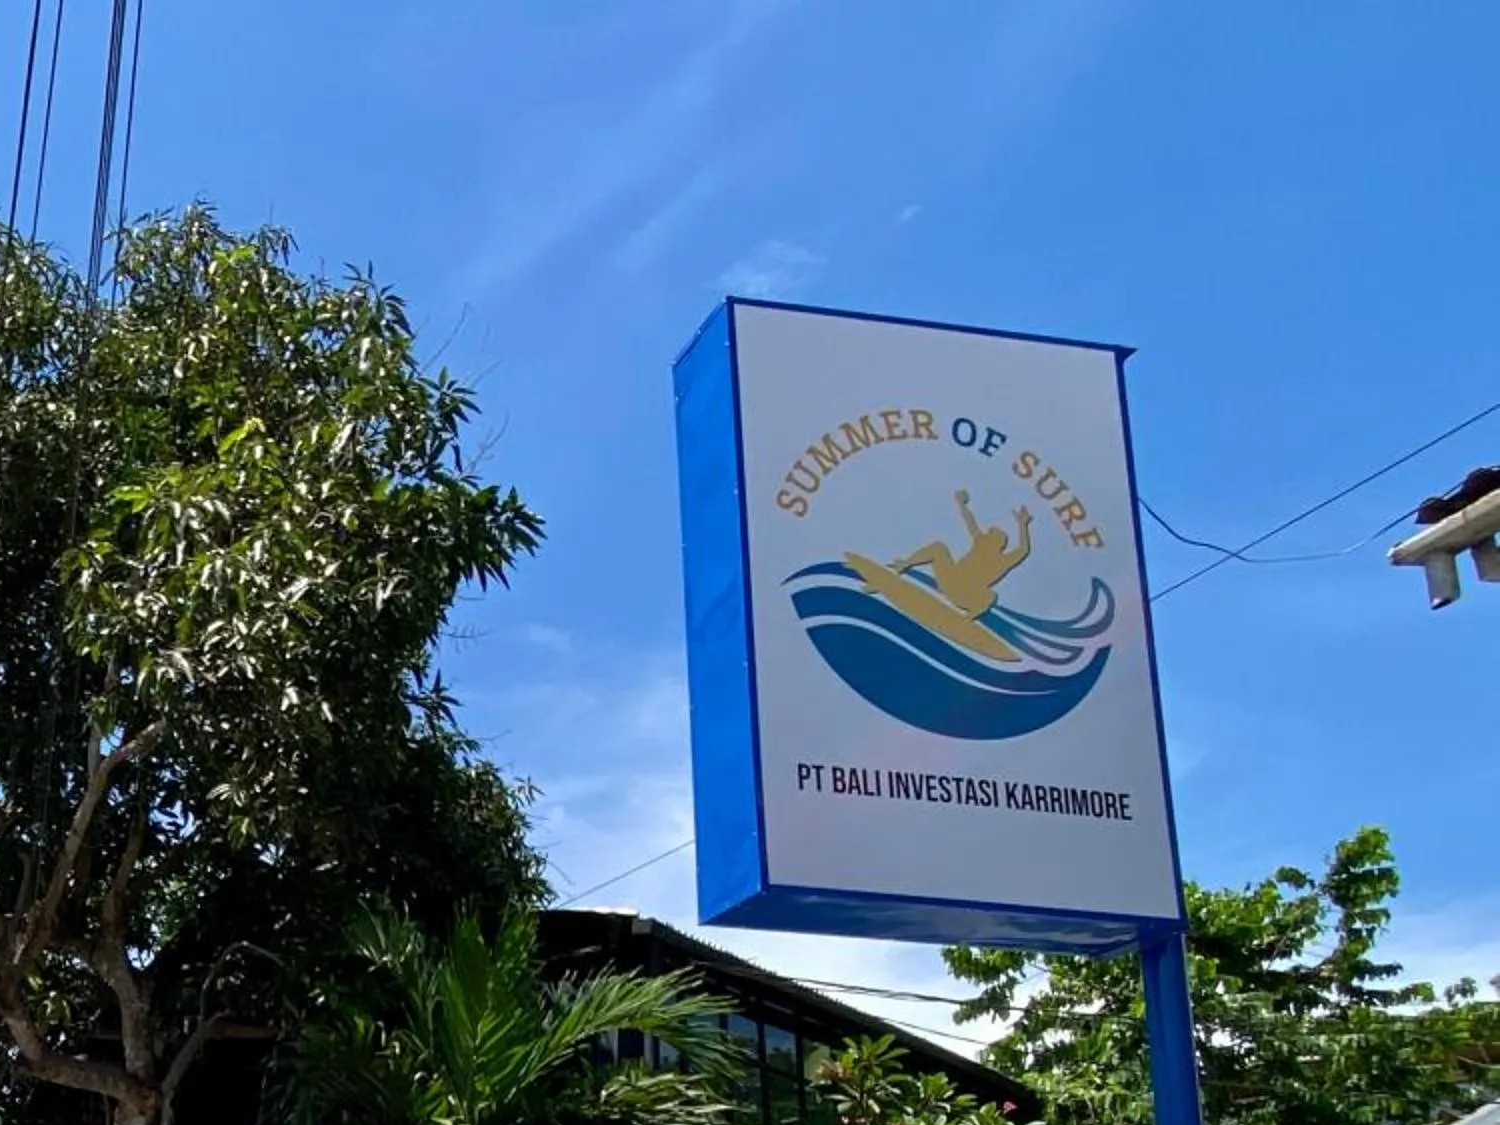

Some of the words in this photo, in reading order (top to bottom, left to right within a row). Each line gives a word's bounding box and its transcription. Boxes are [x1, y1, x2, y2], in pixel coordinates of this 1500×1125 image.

[776, 409, 939, 518] SUMMER
[951, 417, 1007, 457] OF
[1011, 450, 1105, 549] SURF
[797, 763, 824, 792] PT
[831, 766, 881, 797] BALI
[887, 771, 999, 808] INVESTASI
[1004, 782, 1133, 821] KARRIMORE
